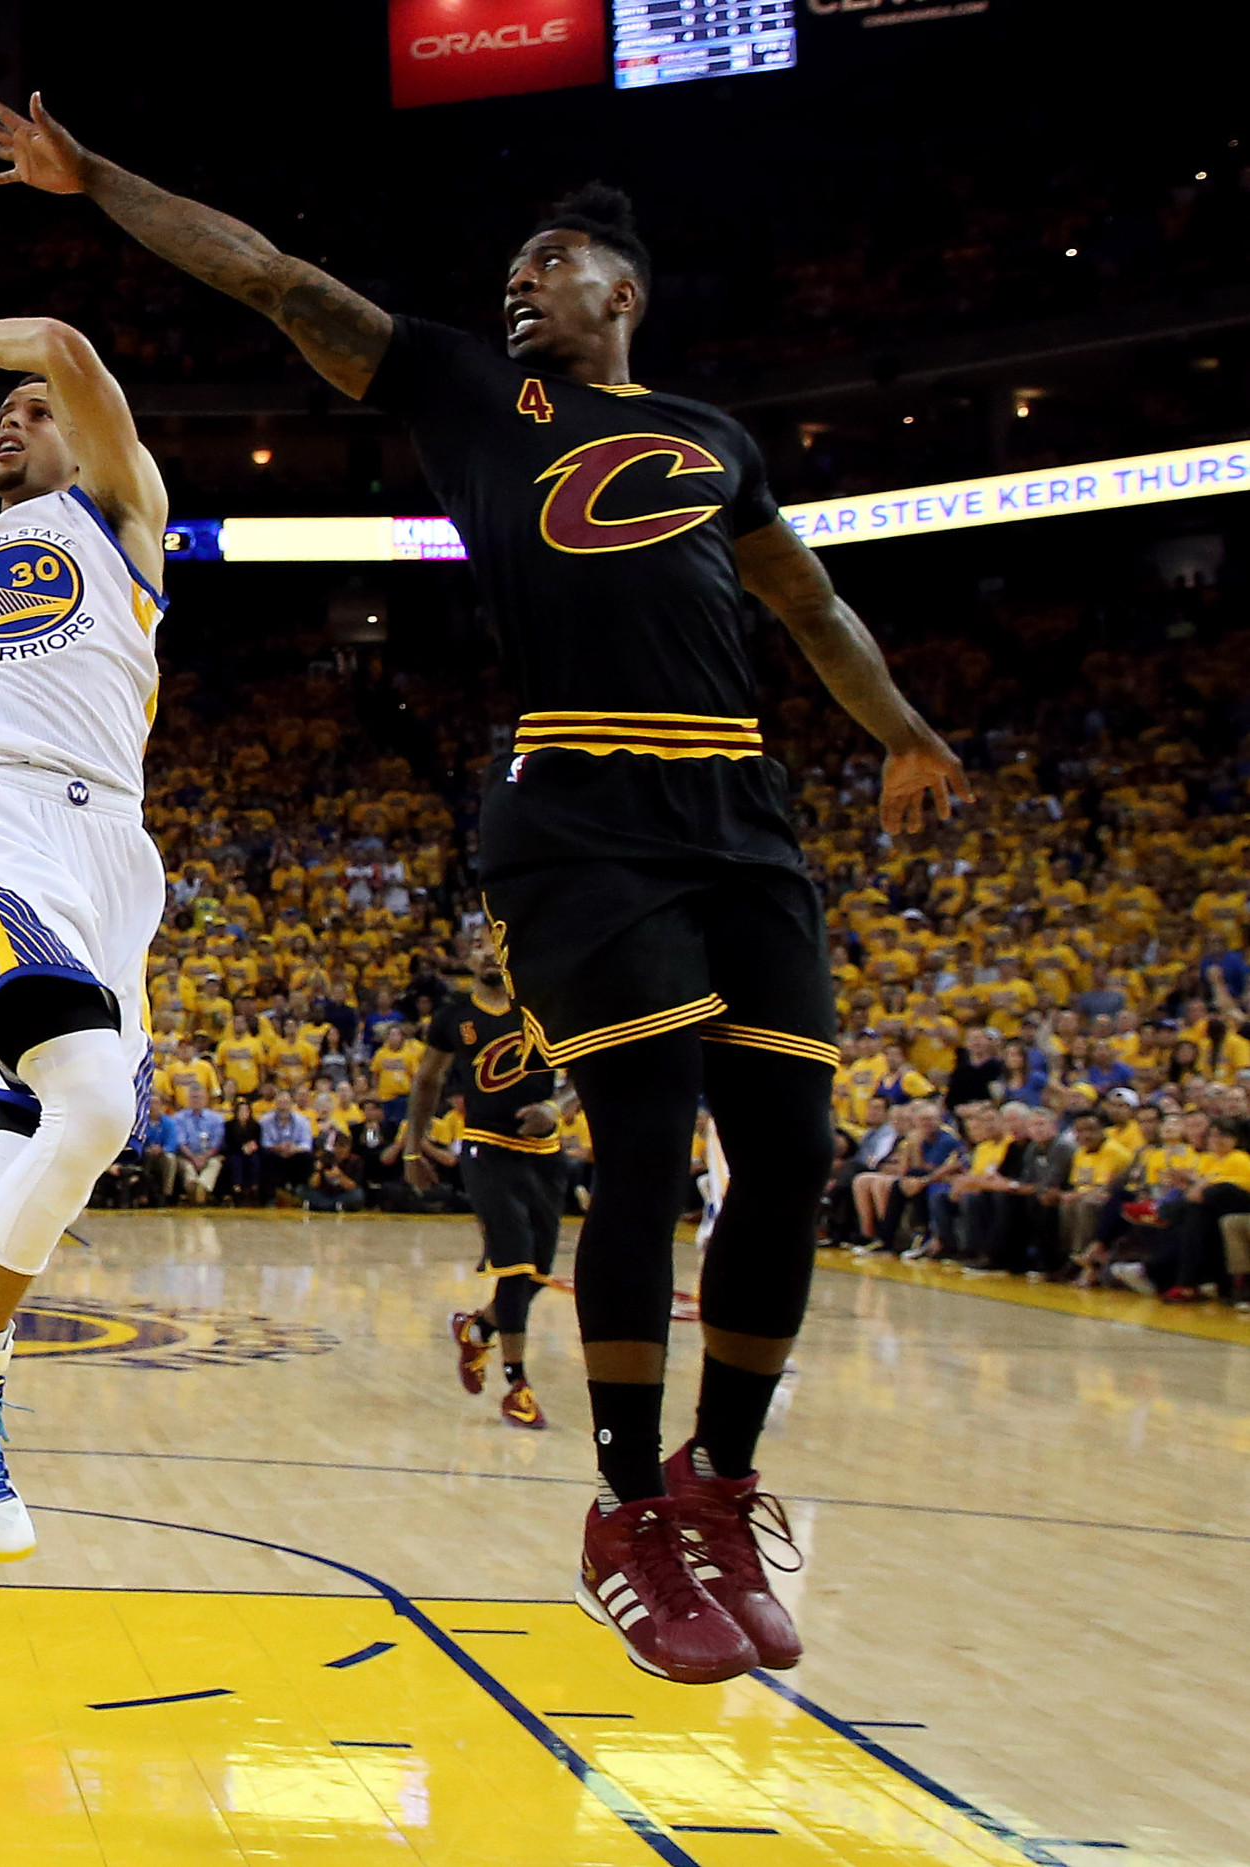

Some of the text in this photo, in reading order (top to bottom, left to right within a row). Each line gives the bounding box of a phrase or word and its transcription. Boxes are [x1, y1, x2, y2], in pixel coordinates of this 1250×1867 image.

[410, 17, 569, 60] ORACLE
[516, 378, 554, 423] 4
[871, 491, 984, 527] STEVE
[999, 475, 1098, 510] KERR
[1113, 454, 1248, 494] THURS
[18, 528, 76, 550] STATE
[9, 555, 60, 587] 30
